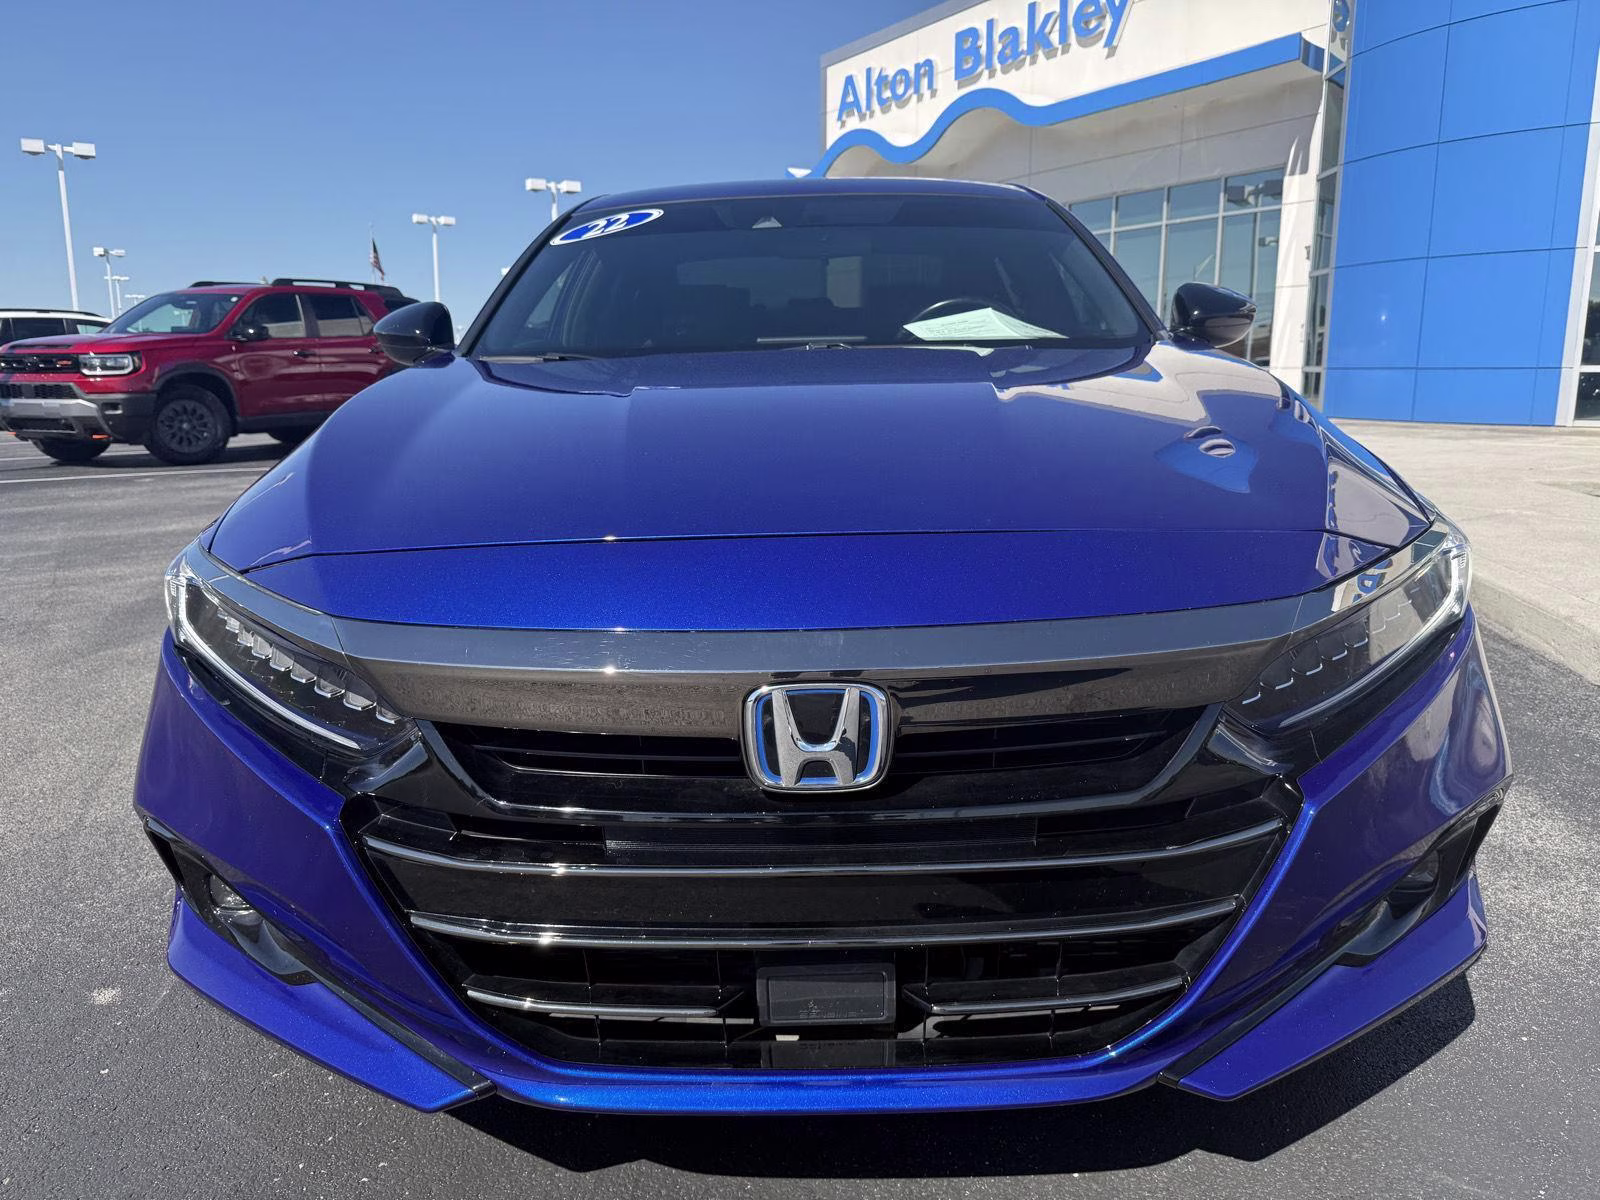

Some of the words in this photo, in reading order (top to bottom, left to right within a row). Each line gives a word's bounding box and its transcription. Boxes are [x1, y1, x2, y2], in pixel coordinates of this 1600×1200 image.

[837, 58, 935, 122] Alton
[954, 0, 1130, 81] Blakley
[580, 213, 630, 240] 22
